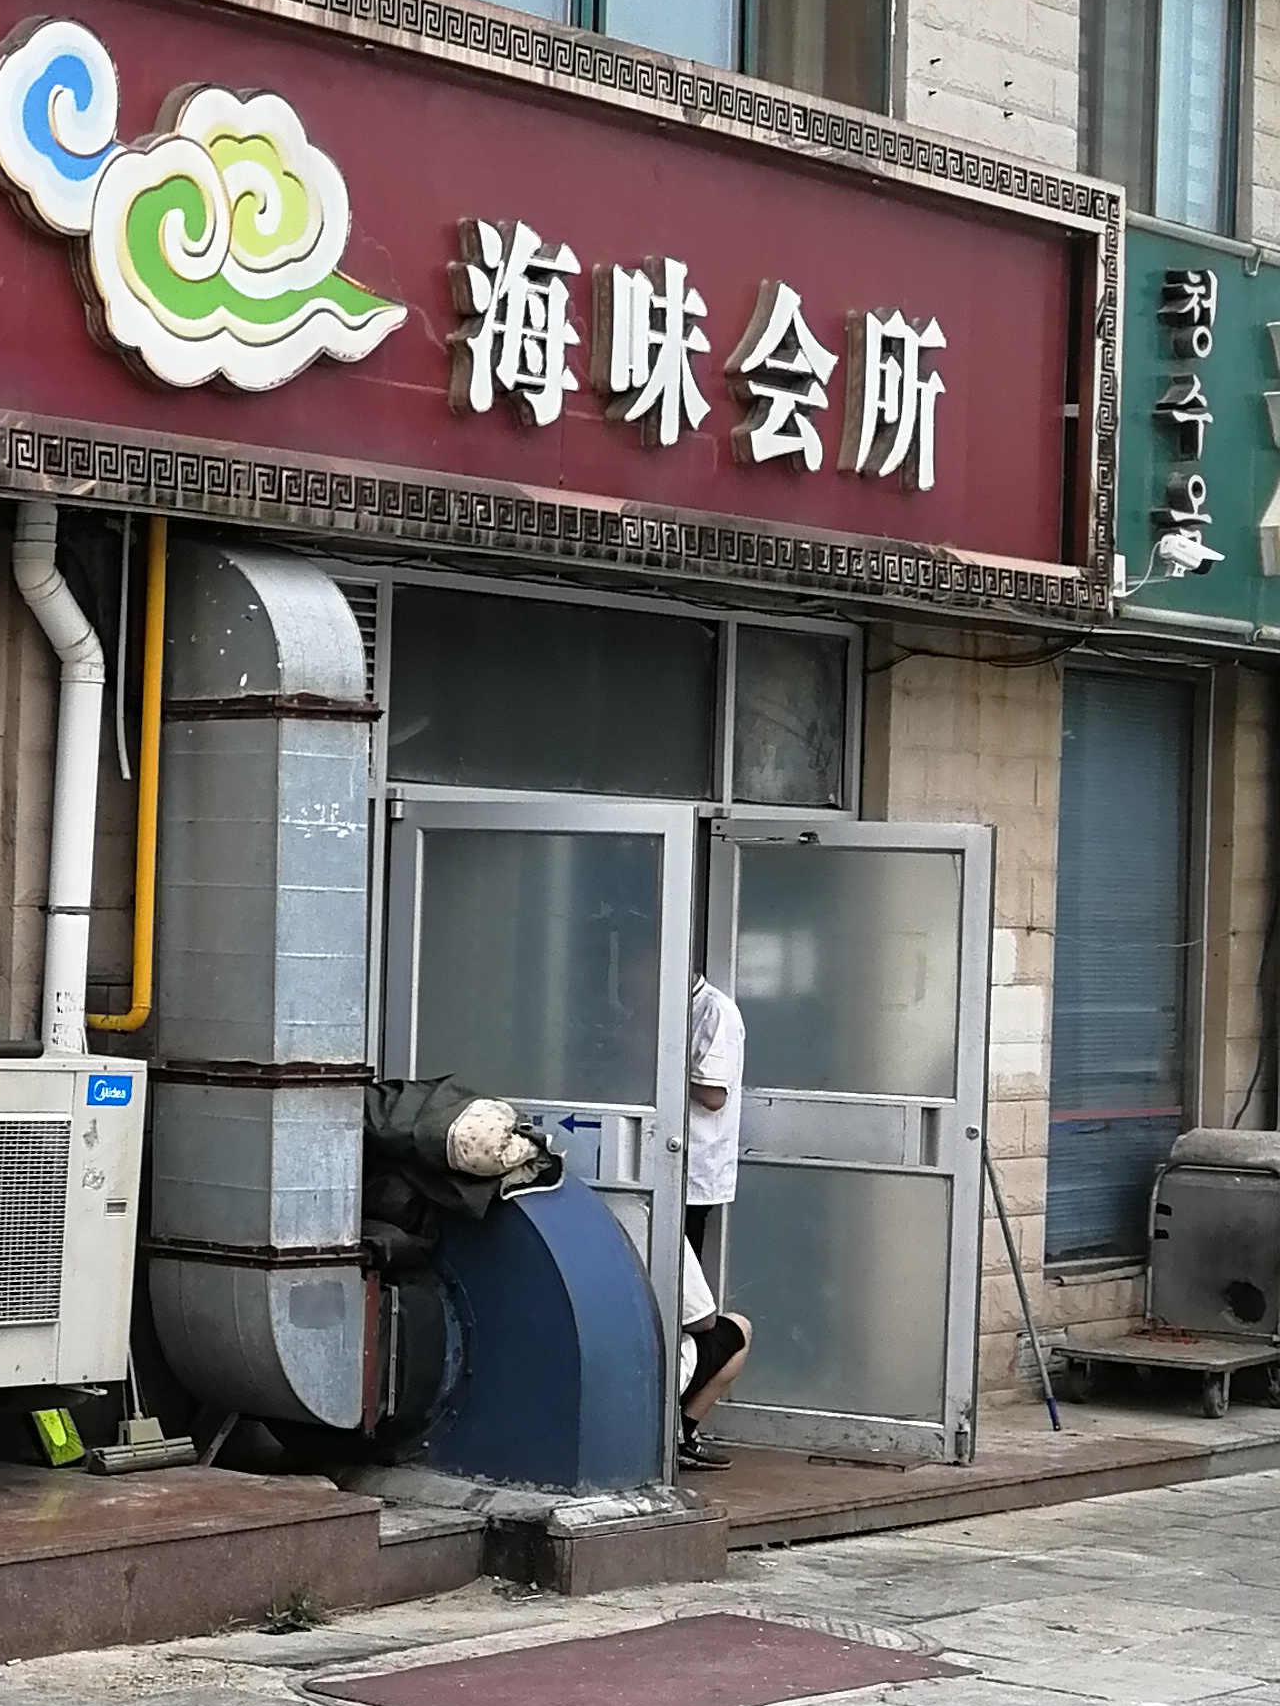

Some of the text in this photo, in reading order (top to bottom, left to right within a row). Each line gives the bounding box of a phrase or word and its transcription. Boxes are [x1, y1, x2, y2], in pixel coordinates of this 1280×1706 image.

[448, 218, 947, 492] 海味会所
[93, 1078, 127, 1102] Midea
